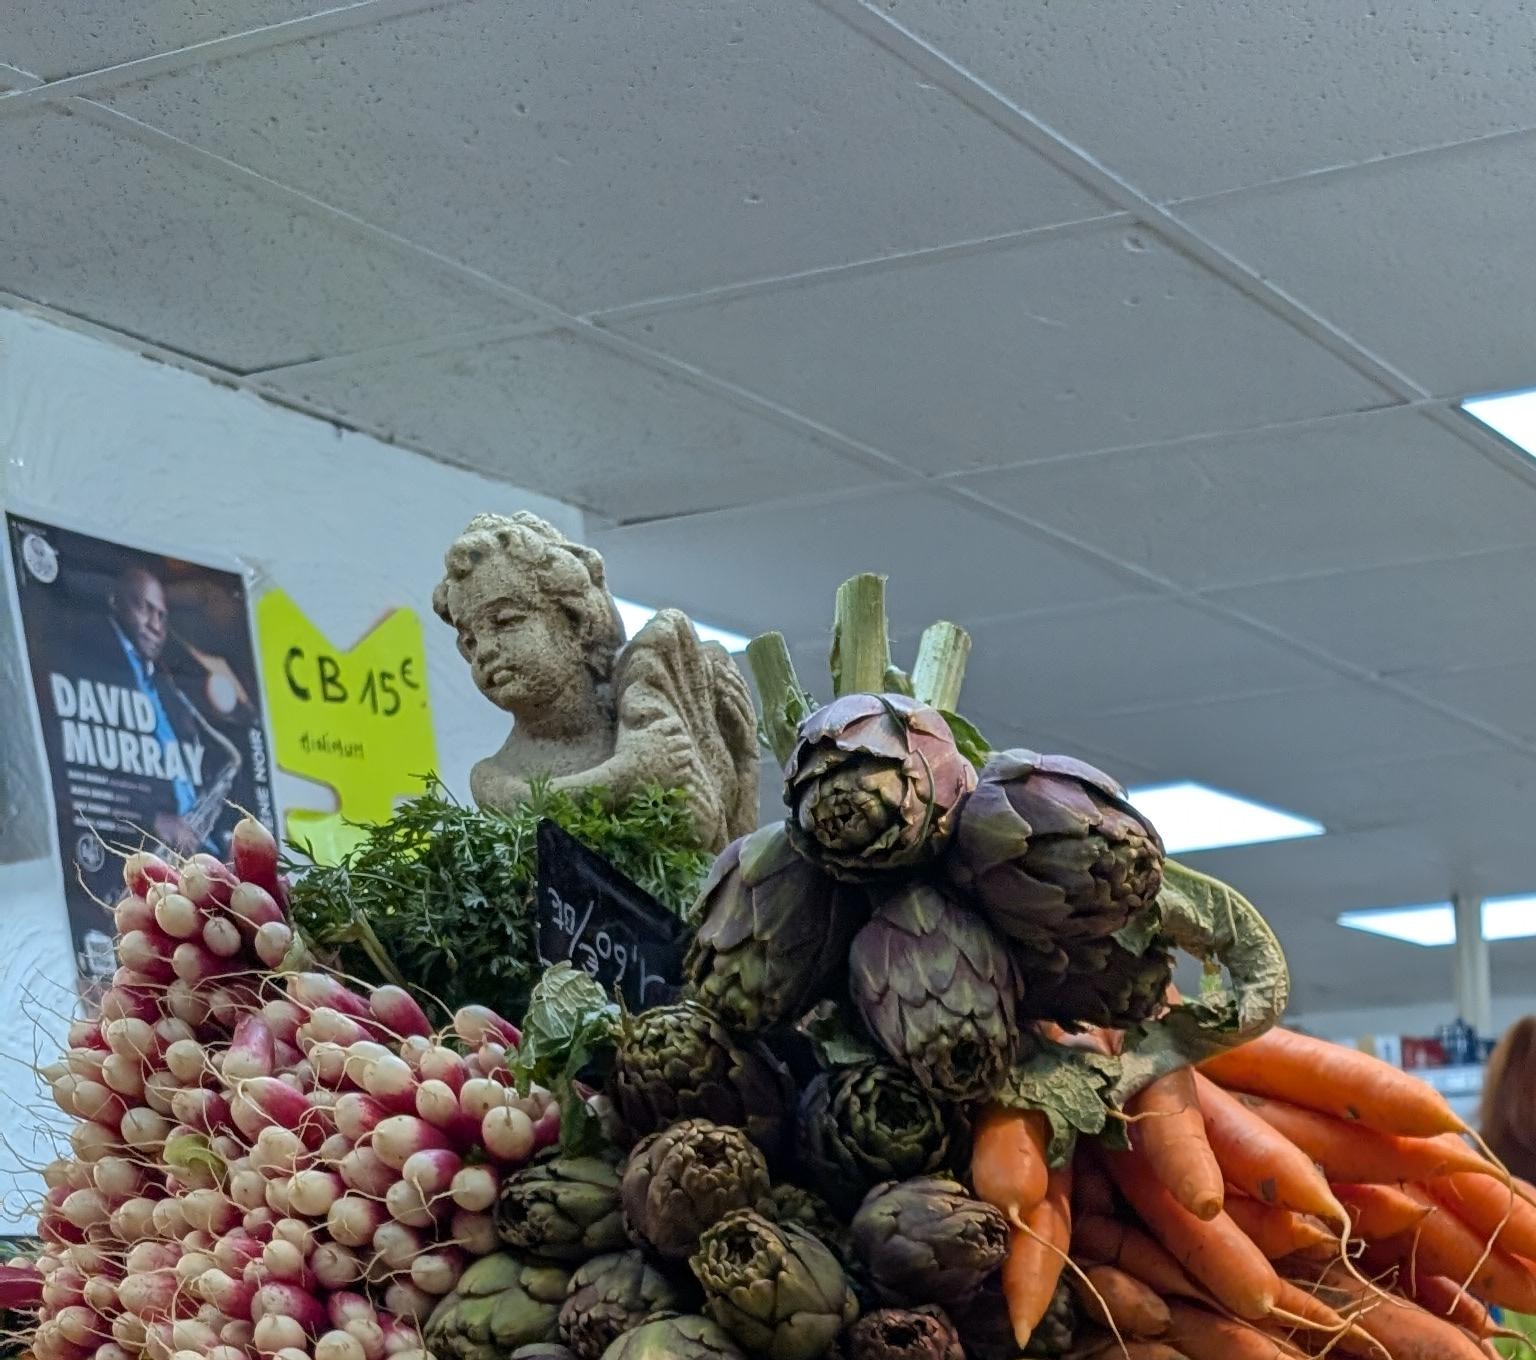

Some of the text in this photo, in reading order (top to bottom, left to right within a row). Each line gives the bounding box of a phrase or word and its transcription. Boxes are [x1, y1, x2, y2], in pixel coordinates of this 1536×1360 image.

[51, 672, 157, 733] DAVID
[284, 647, 420, 716] CB 15€
[62, 719, 205, 786] MURRAY
